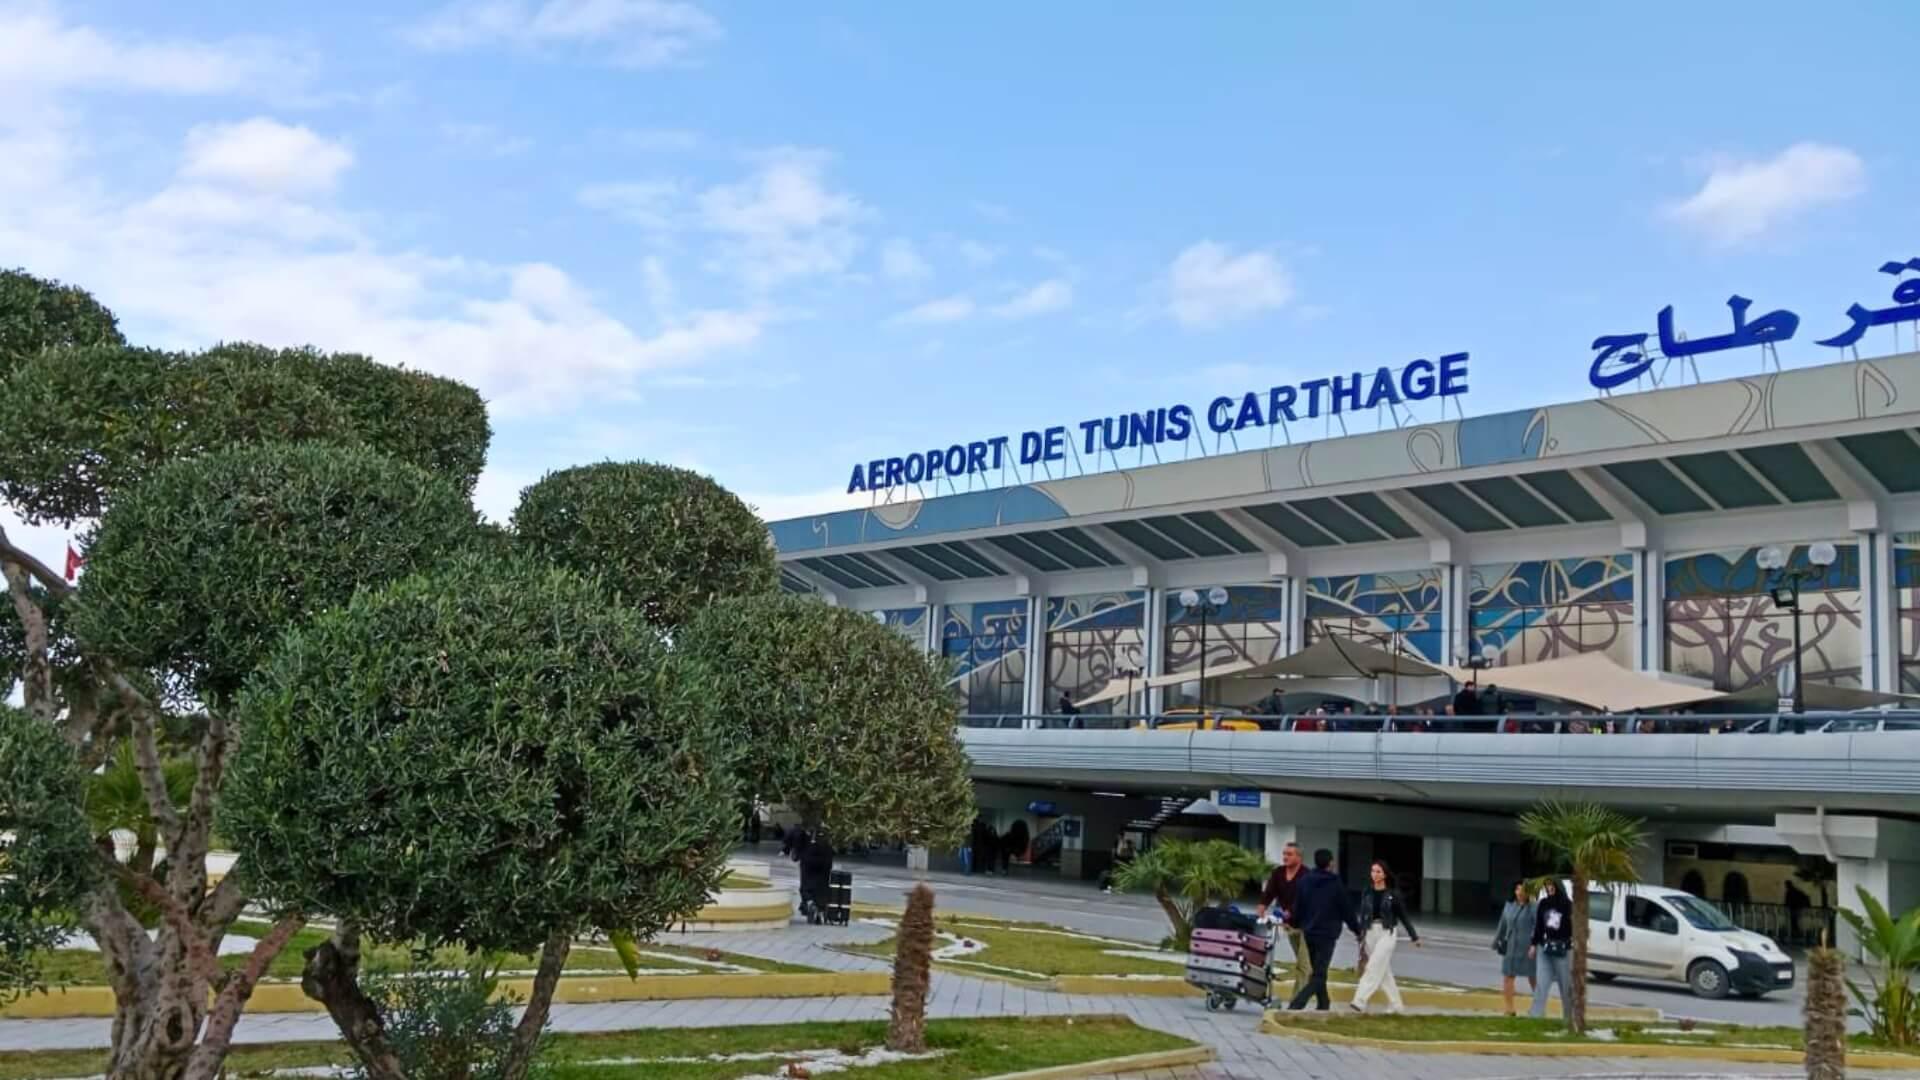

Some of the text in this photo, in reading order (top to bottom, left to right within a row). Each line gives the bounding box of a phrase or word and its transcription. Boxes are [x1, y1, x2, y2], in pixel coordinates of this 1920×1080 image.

[848, 351, 1469, 492] AEROPORT DE TUNIS CARTHAGE
